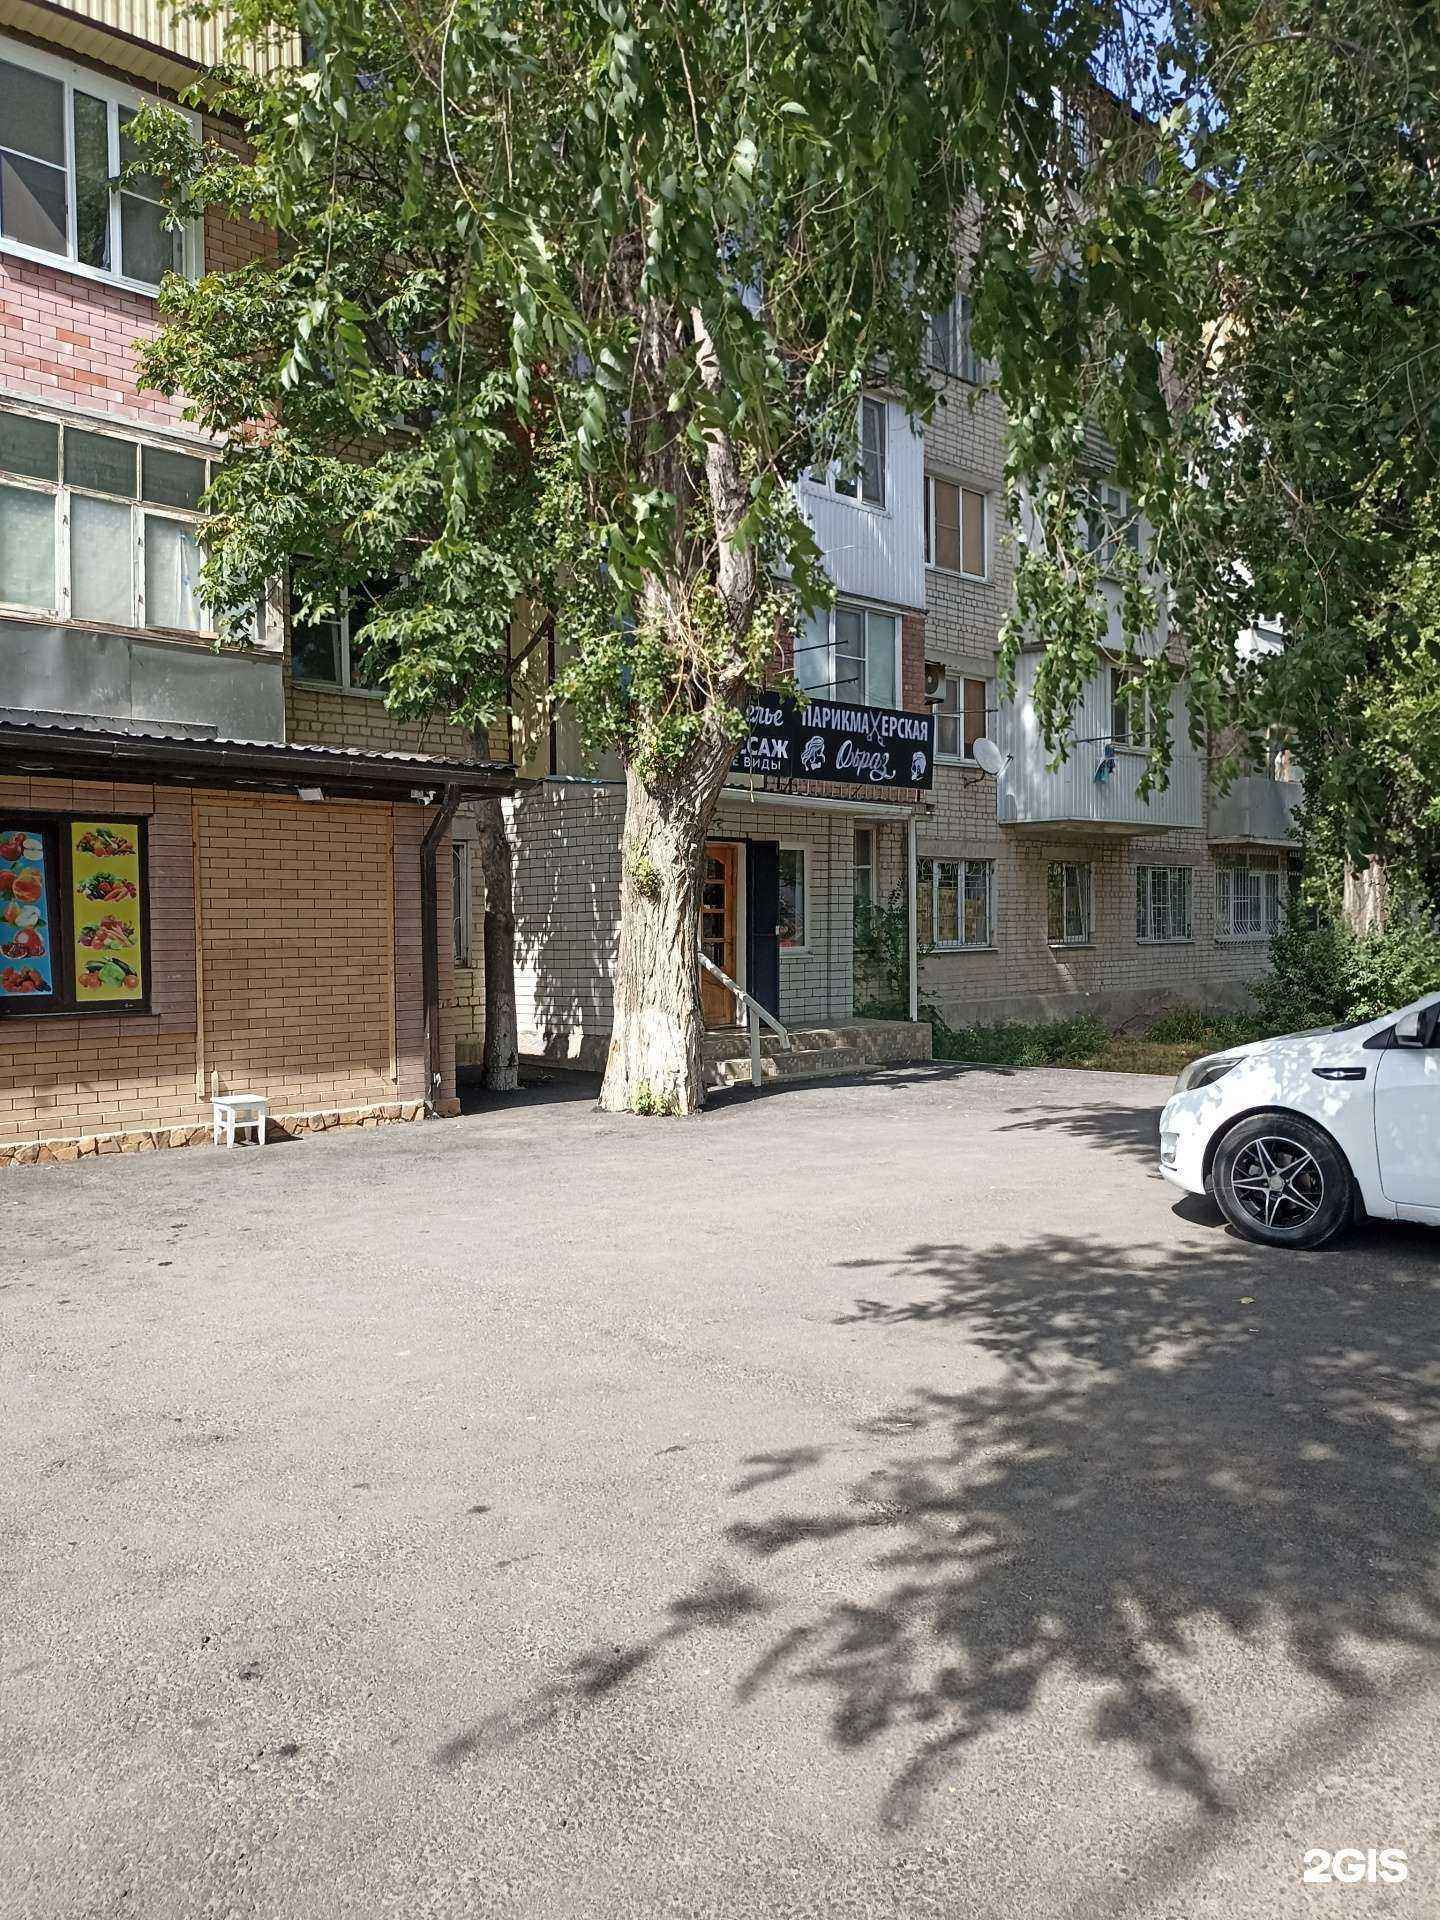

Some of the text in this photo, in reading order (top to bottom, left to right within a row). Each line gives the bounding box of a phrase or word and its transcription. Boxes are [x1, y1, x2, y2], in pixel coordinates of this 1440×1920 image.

[746, 705, 784, 727] елье
[802, 705, 928, 745] ПАРИКМАХЕРСКАЯ
[741, 736, 789, 759] САЖ
[744, 757, 781, 771] ВИДЫ
[835, 739, 896, 782] Образ
